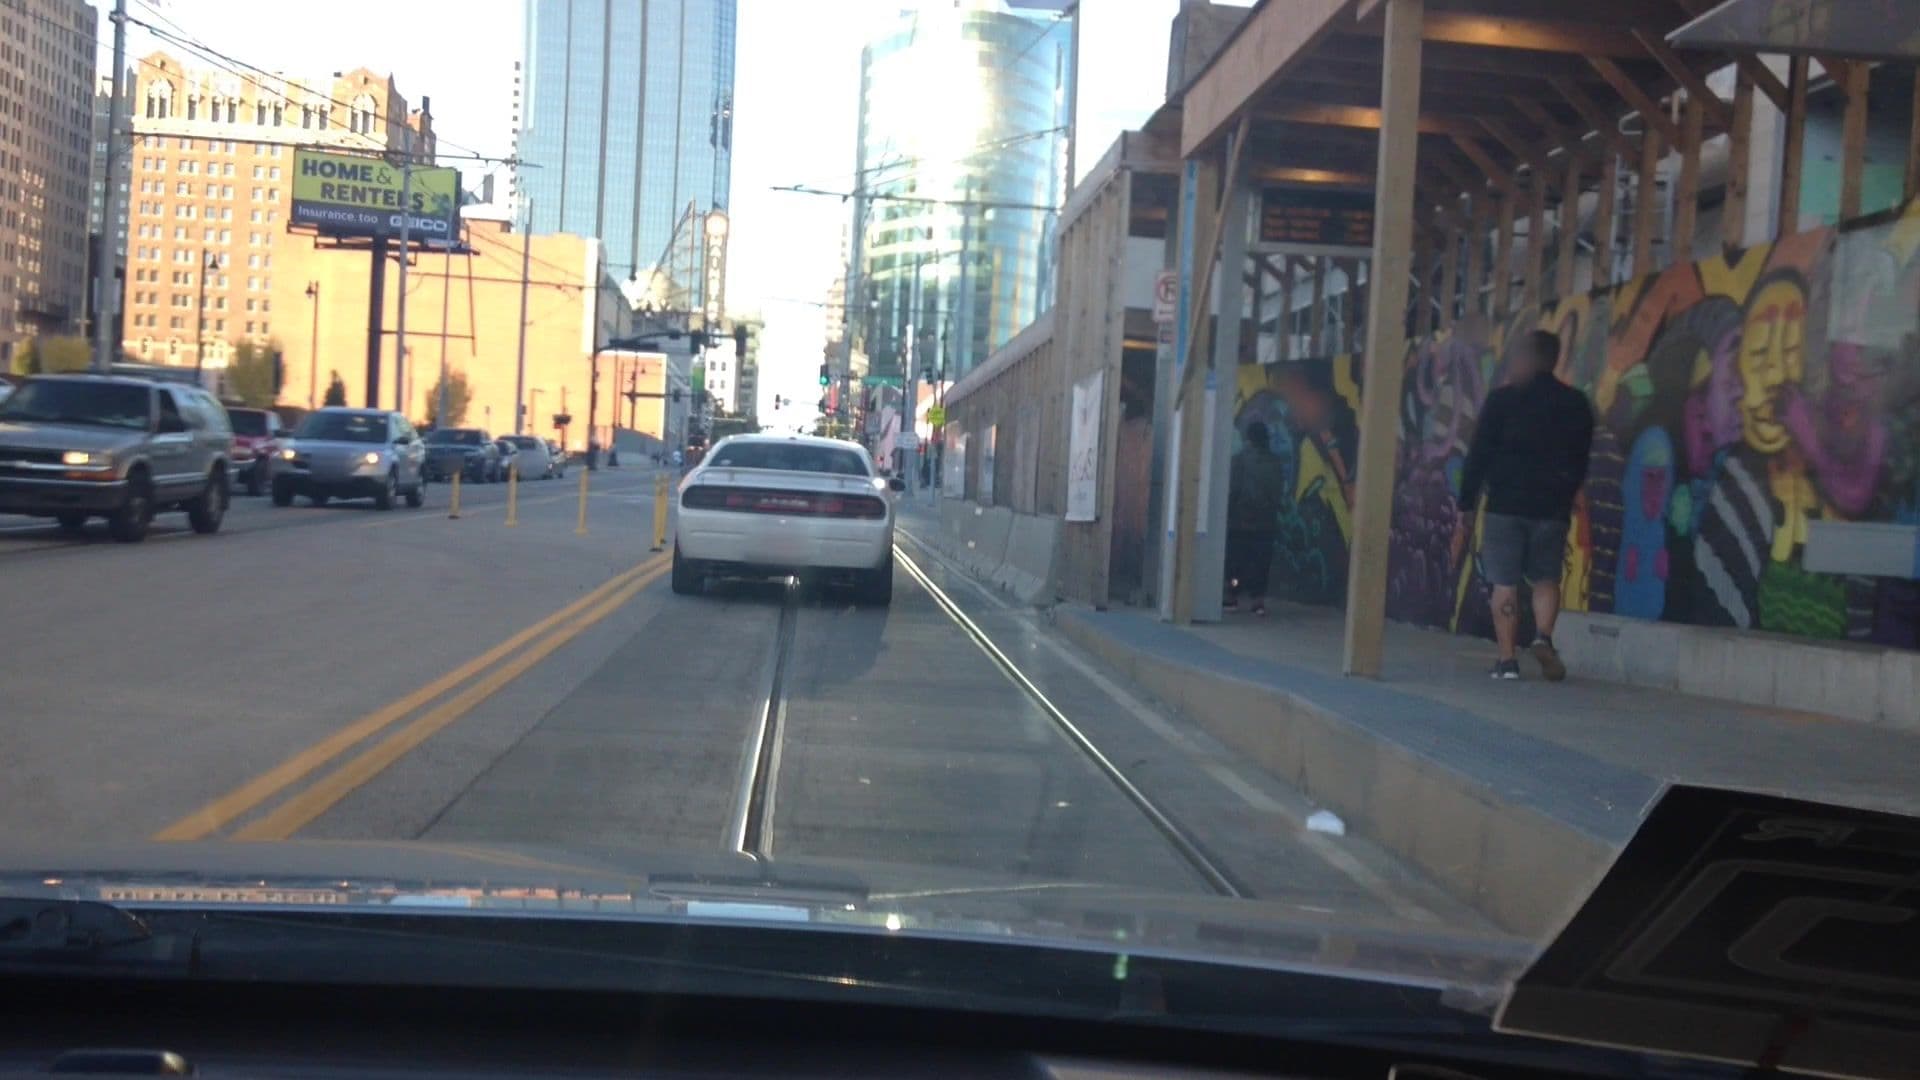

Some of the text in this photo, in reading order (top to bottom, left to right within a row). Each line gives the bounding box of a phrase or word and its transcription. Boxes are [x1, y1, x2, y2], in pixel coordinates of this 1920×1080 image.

[302, 158, 392, 185] HOME &
[359, 213, 378, 224] too
